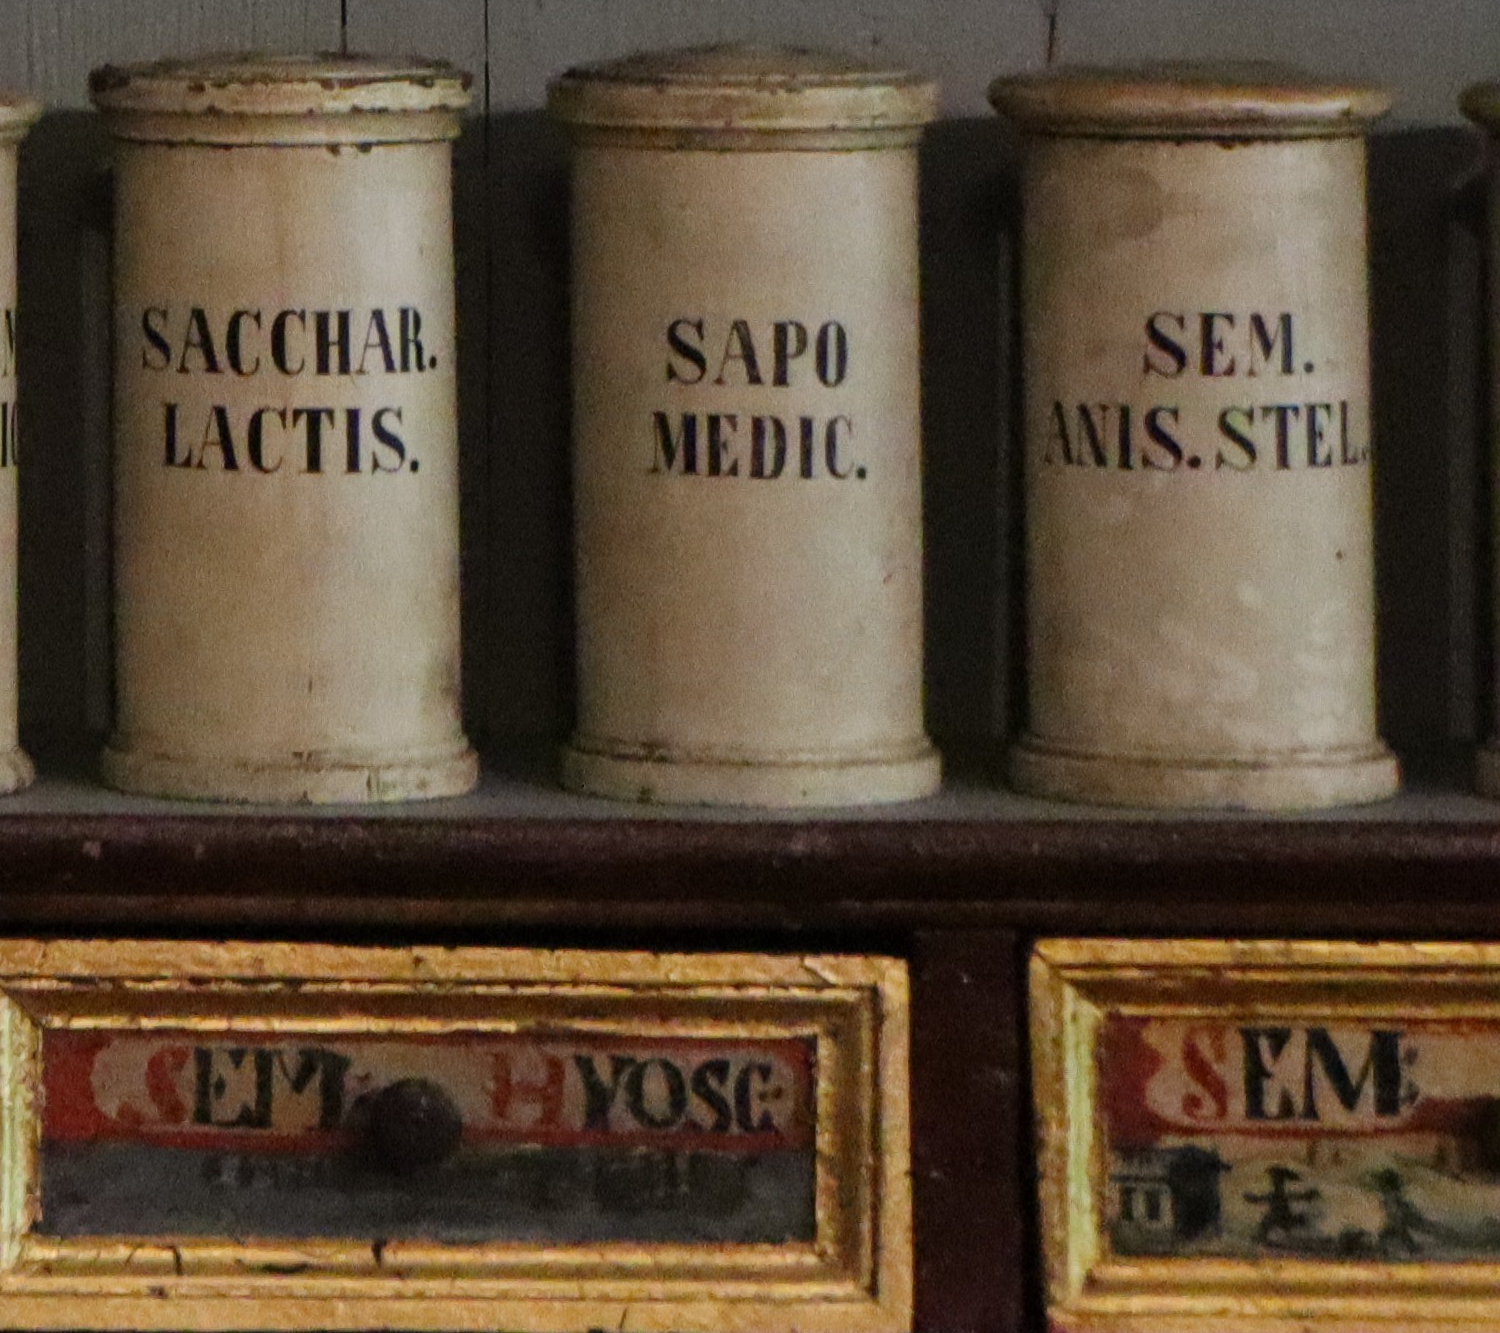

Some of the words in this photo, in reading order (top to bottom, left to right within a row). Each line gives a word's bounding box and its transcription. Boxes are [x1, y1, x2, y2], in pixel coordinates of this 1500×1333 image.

[140, 306, 437, 377] SACCHAR.
[665, 318, 848, 388] SAPO
[1143, 311, 1315, 378] SEM.
[163, 402, 420, 474] LACTIS.
[650, 411, 866, 480] MEDIC.
